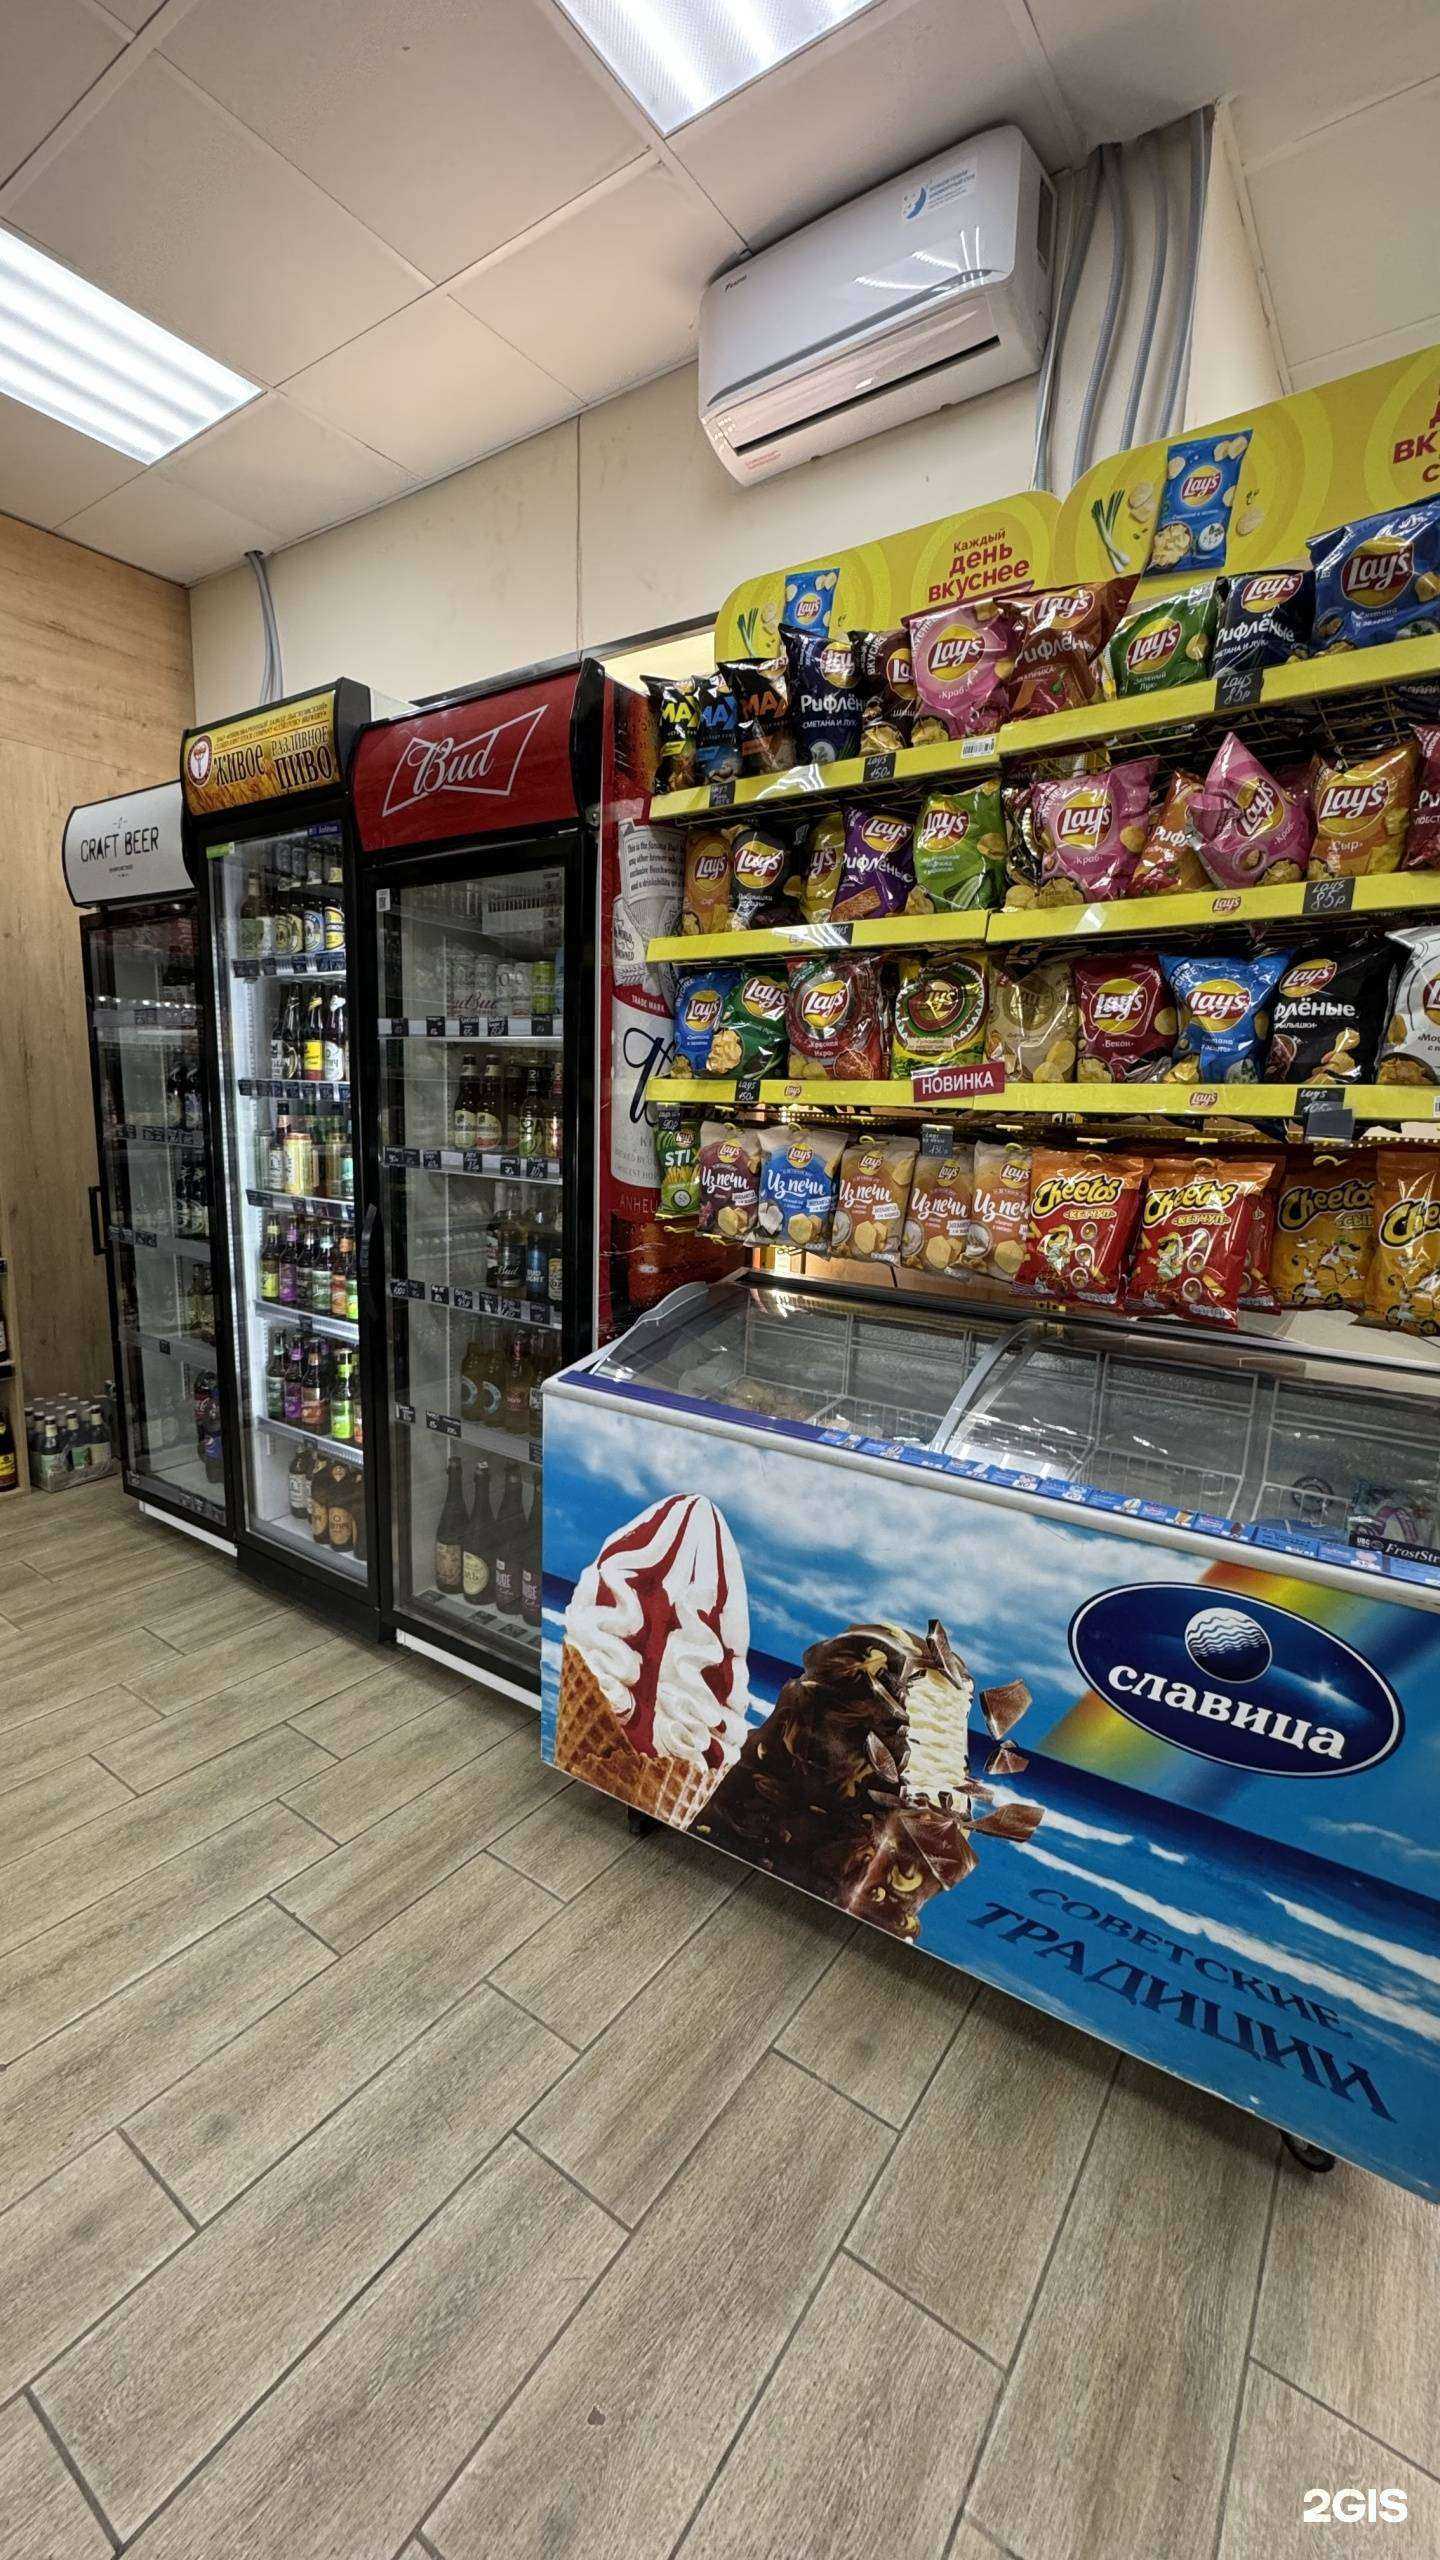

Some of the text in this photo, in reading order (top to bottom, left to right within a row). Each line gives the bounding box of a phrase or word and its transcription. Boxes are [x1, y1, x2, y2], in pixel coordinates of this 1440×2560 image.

[953, 528, 1006, 554] Каждый
[949, 543, 1013, 577] день
[1347, 548, 1411, 591] Lay's
[928, 559, 1030, 602] вкуснее
[1247, 574, 1299, 600] Lay's
[931, 637, 983, 669] Lay's
[1131, 624, 1179, 667] Lay's
[271, 725, 329, 757] РАЗЛИВНОЕ
[273, 745, 333, 790] ПИВО
[407, 737, 494, 796] Bud
[1320, 779, 1388, 820] Lay's
[866, 819, 912, 841] Lay's
[1061, 805, 1112, 836] Lay's
[80, 826, 159, 863] CRAFT BEER
[697, 856, 726, 880] Lay's
[1282, 965, 1335, 988] Lay's
[687, 999, 719, 1023] Lay's
[805, 989, 846, 1018] Lay's
[1190, 990, 1248, 1019] Lay's
[922, 1070, 994, 1095] НОВИНКА
[665, 1149, 691, 1167] STI
[1031, 1174, 1124, 1218] Cheetos
[1143, 1180, 1239, 1228] Cheetos
[1385, 1543, 1440, 1563] FrostStr
[1107, 1664, 1346, 1760] славица
[1029, 1888, 1354, 2039] СОВЕТСКИЕ
[966, 1902, 1396, 2124] ТРАДИЦИИ
